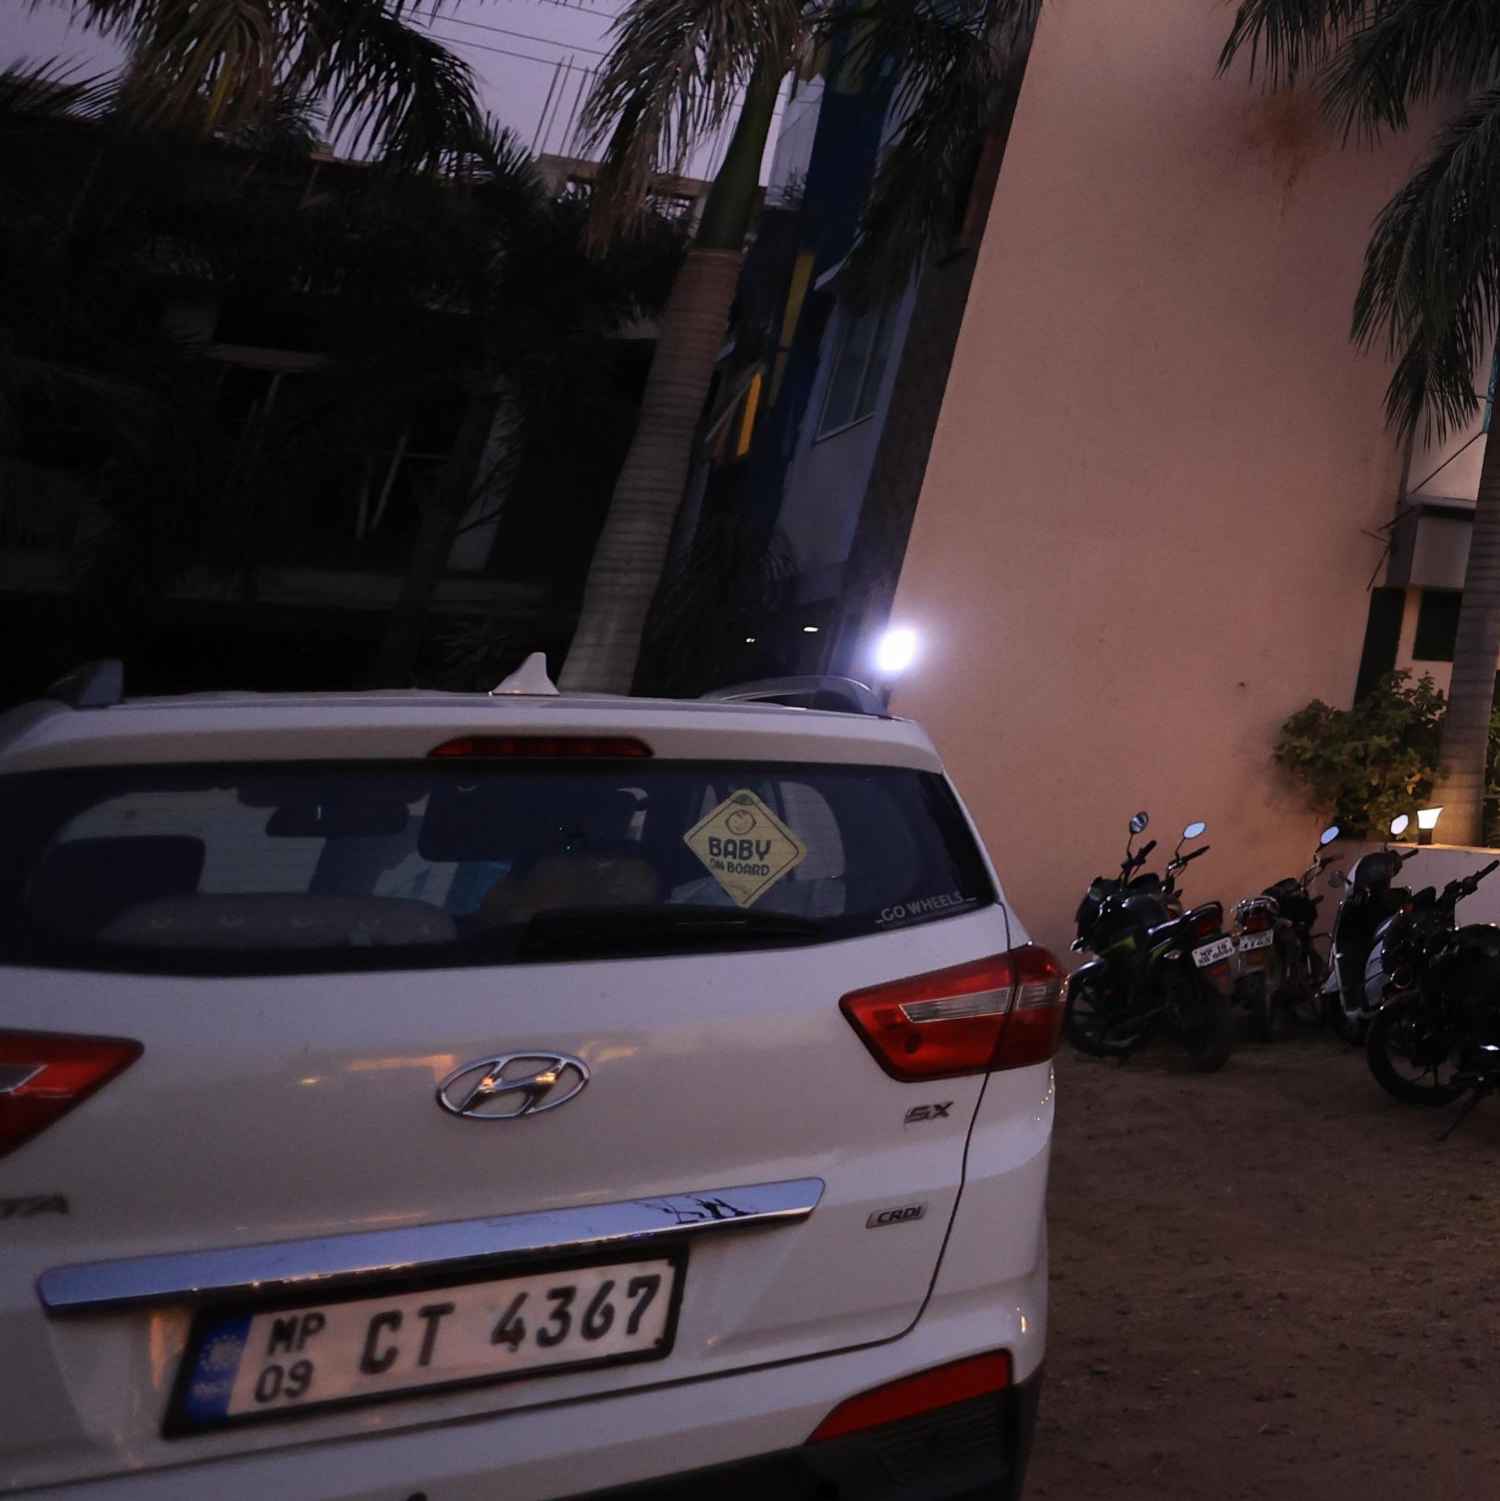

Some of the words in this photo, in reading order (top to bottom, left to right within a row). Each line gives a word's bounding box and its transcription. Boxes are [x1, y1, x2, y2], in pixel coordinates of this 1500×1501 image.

[708, 836, 771, 861] BABY
[710, 858, 725, 871] ON
[727, 862, 770, 876] BOARD
[904, 1101, 954, 1123] SX
[266, 1311, 327, 1356] MP
[359, 1301, 456, 1377] CT
[491, 1273, 661, 1353] 4367
[254, 1360, 316, 1405] 09
